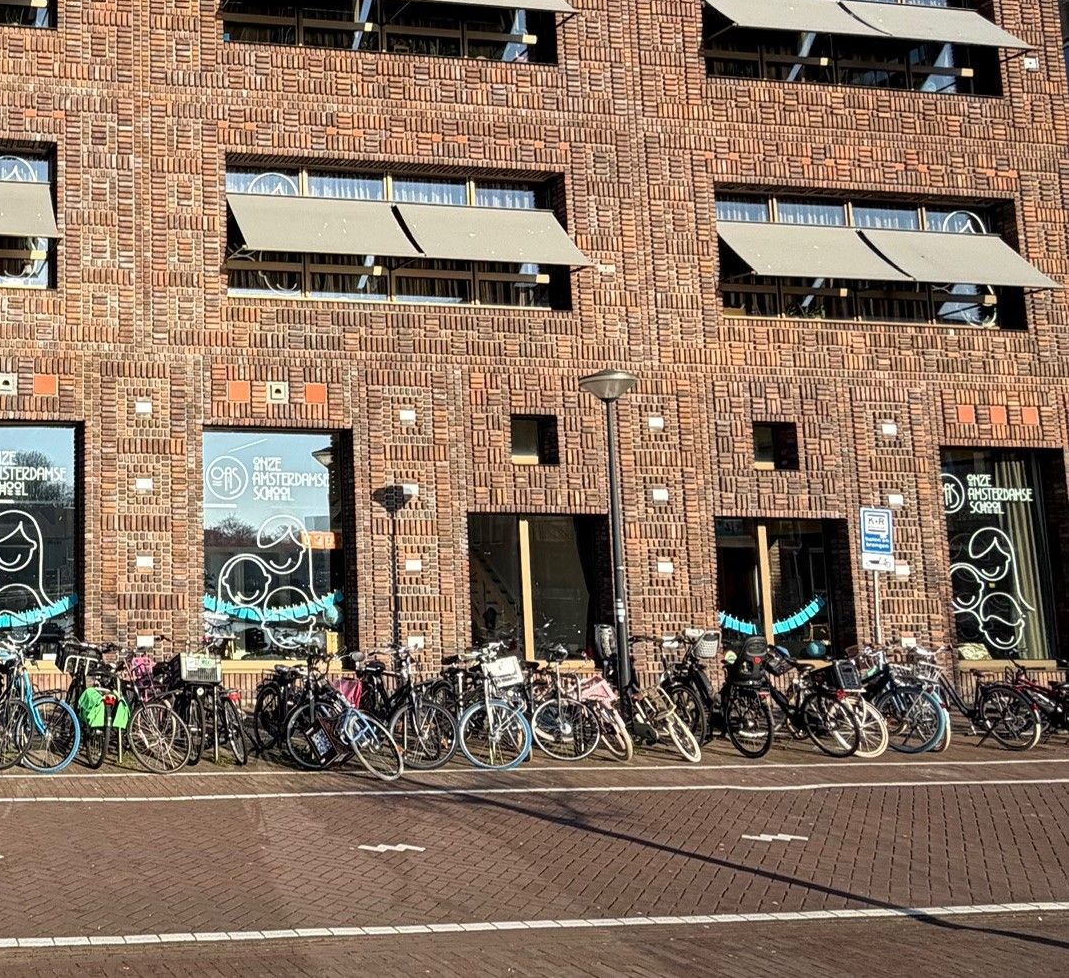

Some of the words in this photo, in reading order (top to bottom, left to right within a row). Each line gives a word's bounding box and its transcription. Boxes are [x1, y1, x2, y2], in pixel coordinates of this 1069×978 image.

[252, 456, 282, 472] ONZE
[966, 473, 992, 487] ONZE
[252, 485, 295, 501] SCHOOL
[967, 487, 1034, 502] AMSTERDAMSE
[969, 501, 1005, 515] SCHOOL
